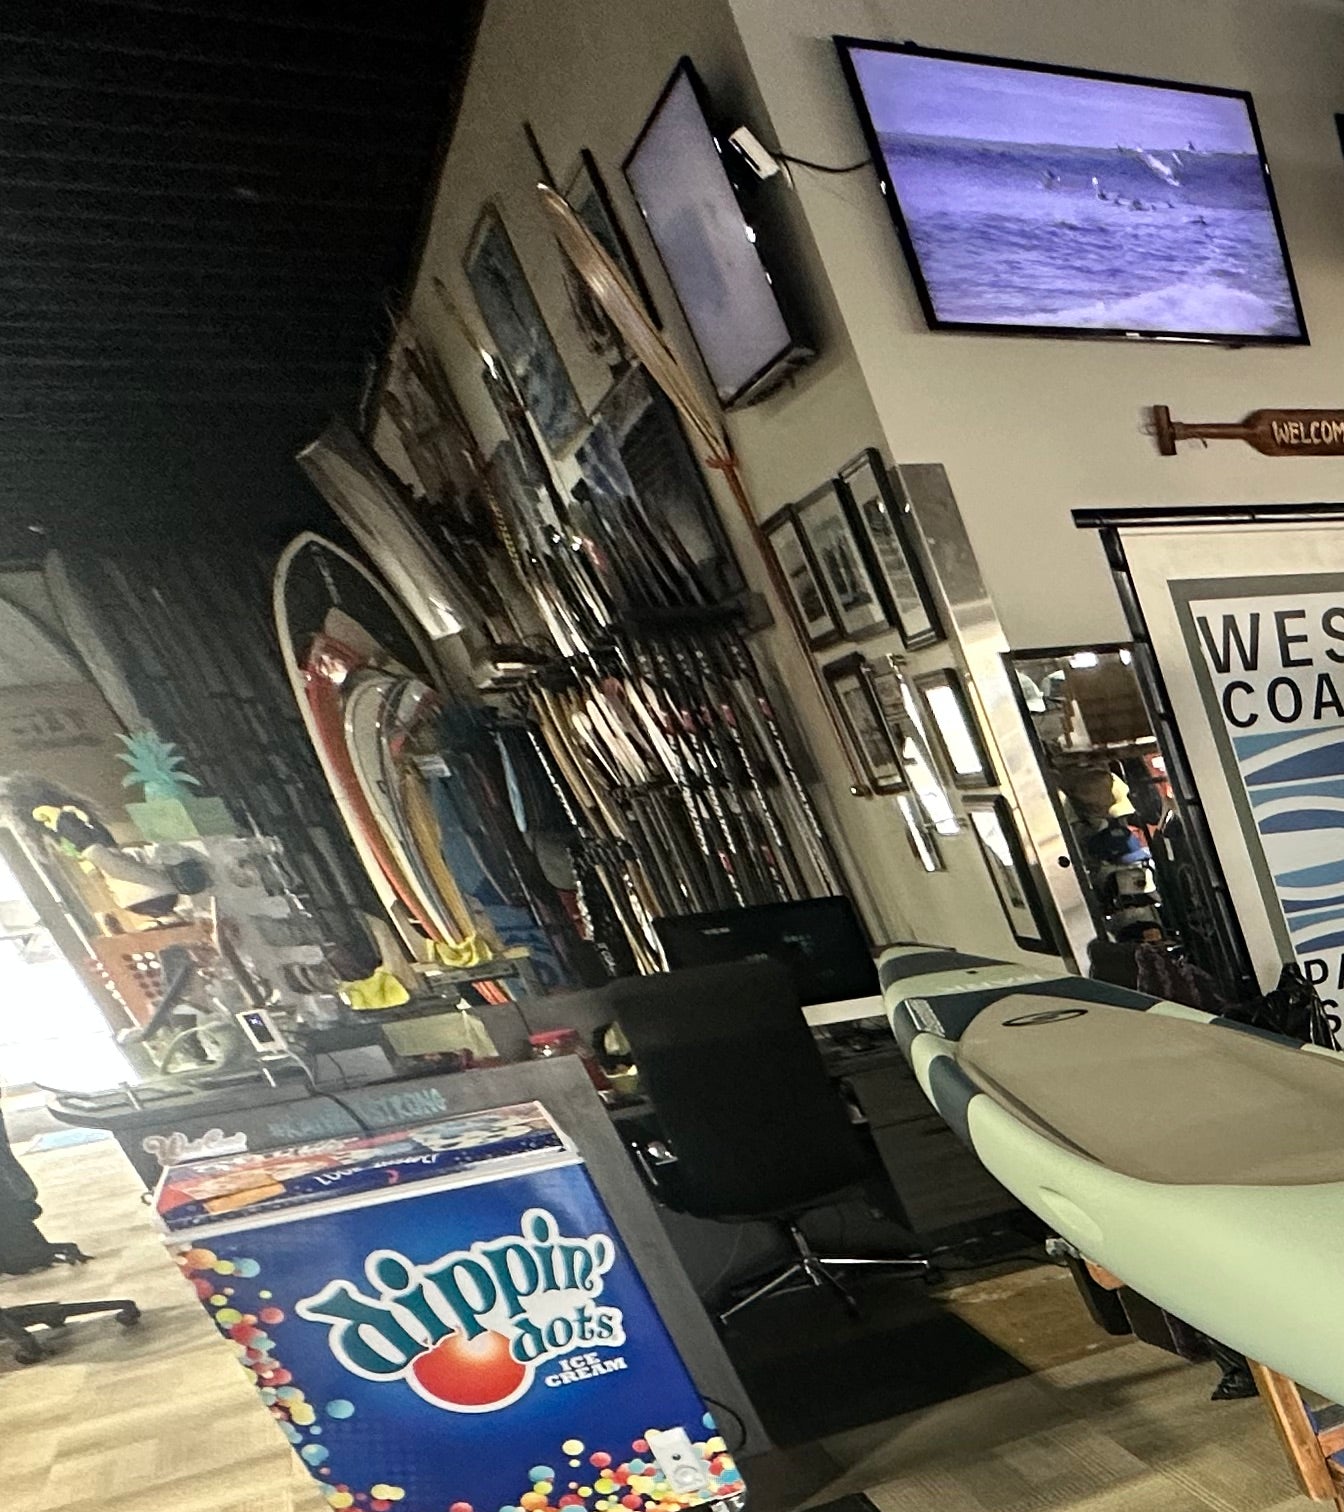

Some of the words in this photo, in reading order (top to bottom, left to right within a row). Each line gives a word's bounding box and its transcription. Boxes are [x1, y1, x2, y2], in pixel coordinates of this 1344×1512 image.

[511, 1304, 616, 1364] dots
[544, 1356, 628, 1388] CREAM
[557, 1351, 603, 1372] ICE
